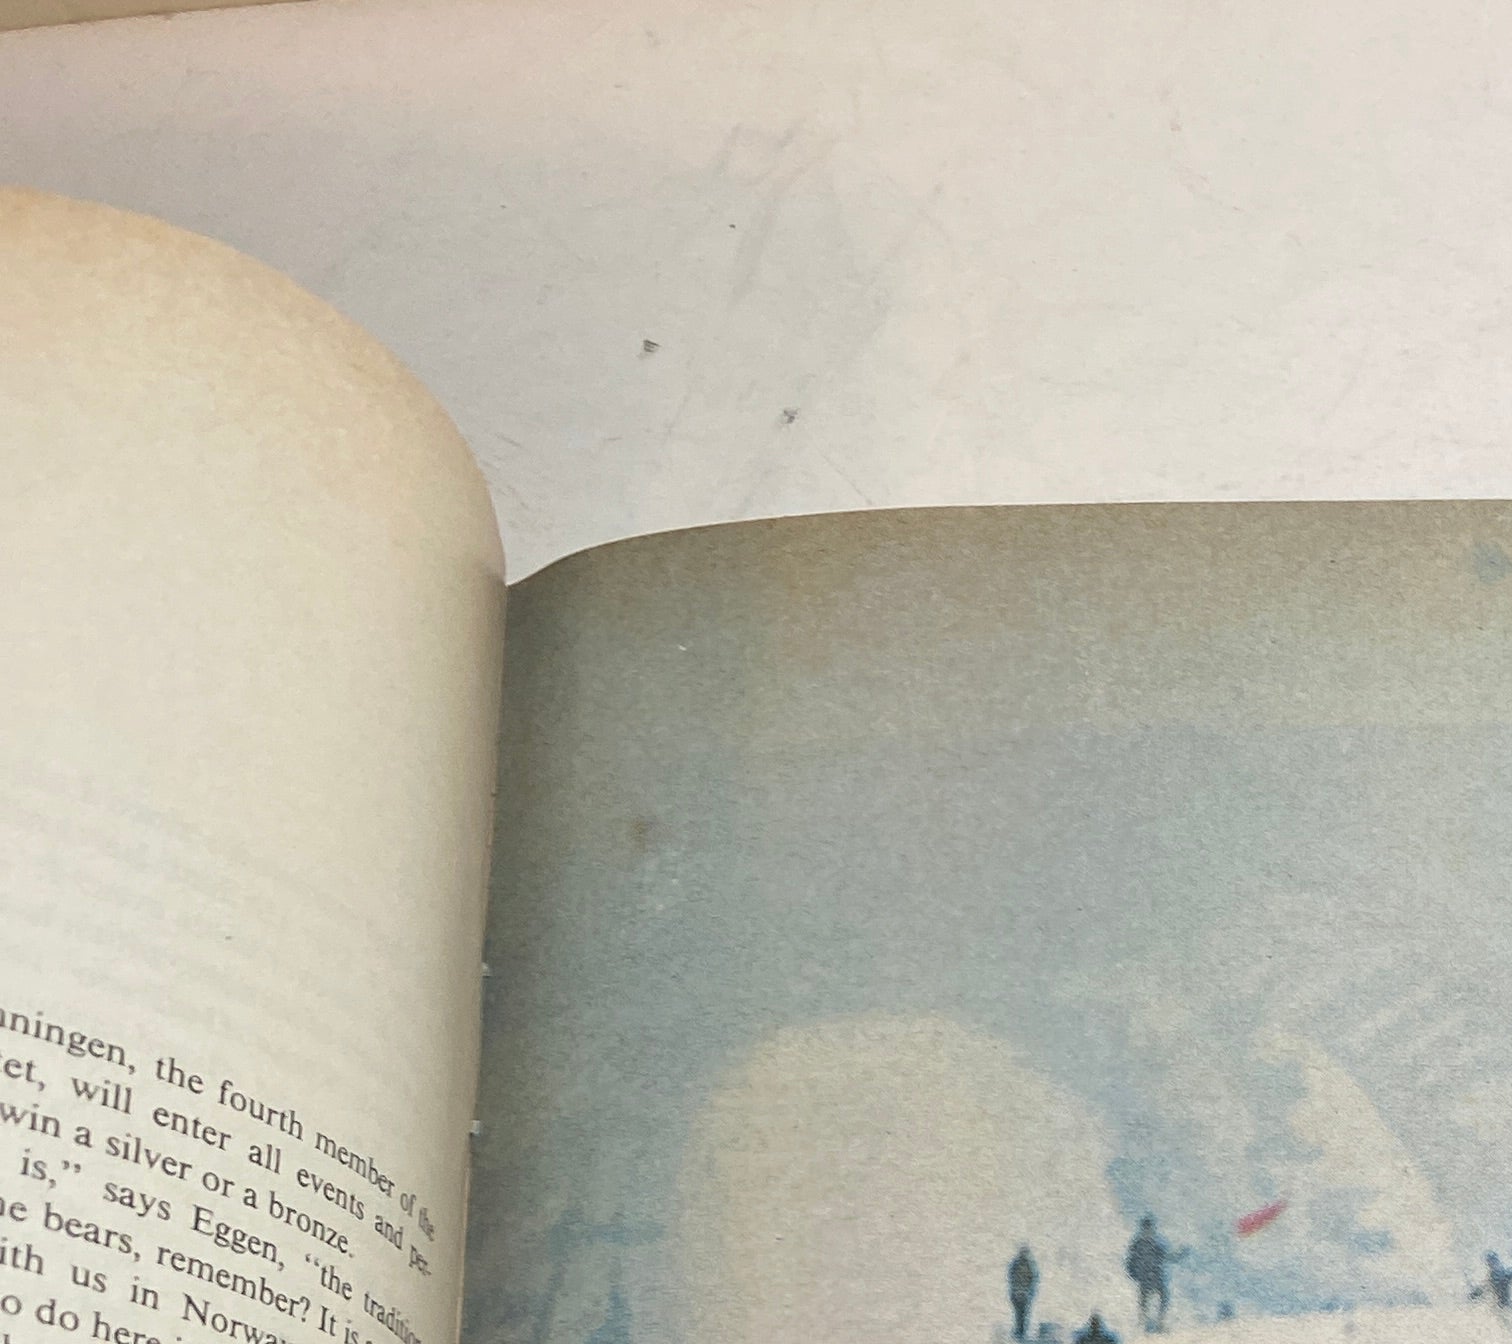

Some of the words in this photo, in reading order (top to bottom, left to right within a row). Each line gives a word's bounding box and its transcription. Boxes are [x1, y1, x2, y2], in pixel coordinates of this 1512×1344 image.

[0, 1103, 61, 1138] win
[105, 1134, 193, 1181] silver
[270, 1191, 355, 1258] bronze.
[71, 1076, 133, 1114] will
[153, 1106, 232, 1151] enter
[248, 1142, 282, 1174] all
[297, 1169, 365, 1220] events
[374, 1209, 403, 1250] and
[155, 1056, 205, 1094] the
[219, 1080, 304, 1141] fourth
[314, 1130, 395, 1198] member
[399, 1189, 418, 1218] of
[44, 1202, 141, 1262] bears,
[156, 1244, 311, 1324] remember?
[71, 1264, 107, 1292] us
[130, 1277, 159, 1309] in
[104, 1180, 172, 1221] says
[192, 1205, 285, 1271] Eggen,
[35, 1296, 80, 1332] do
